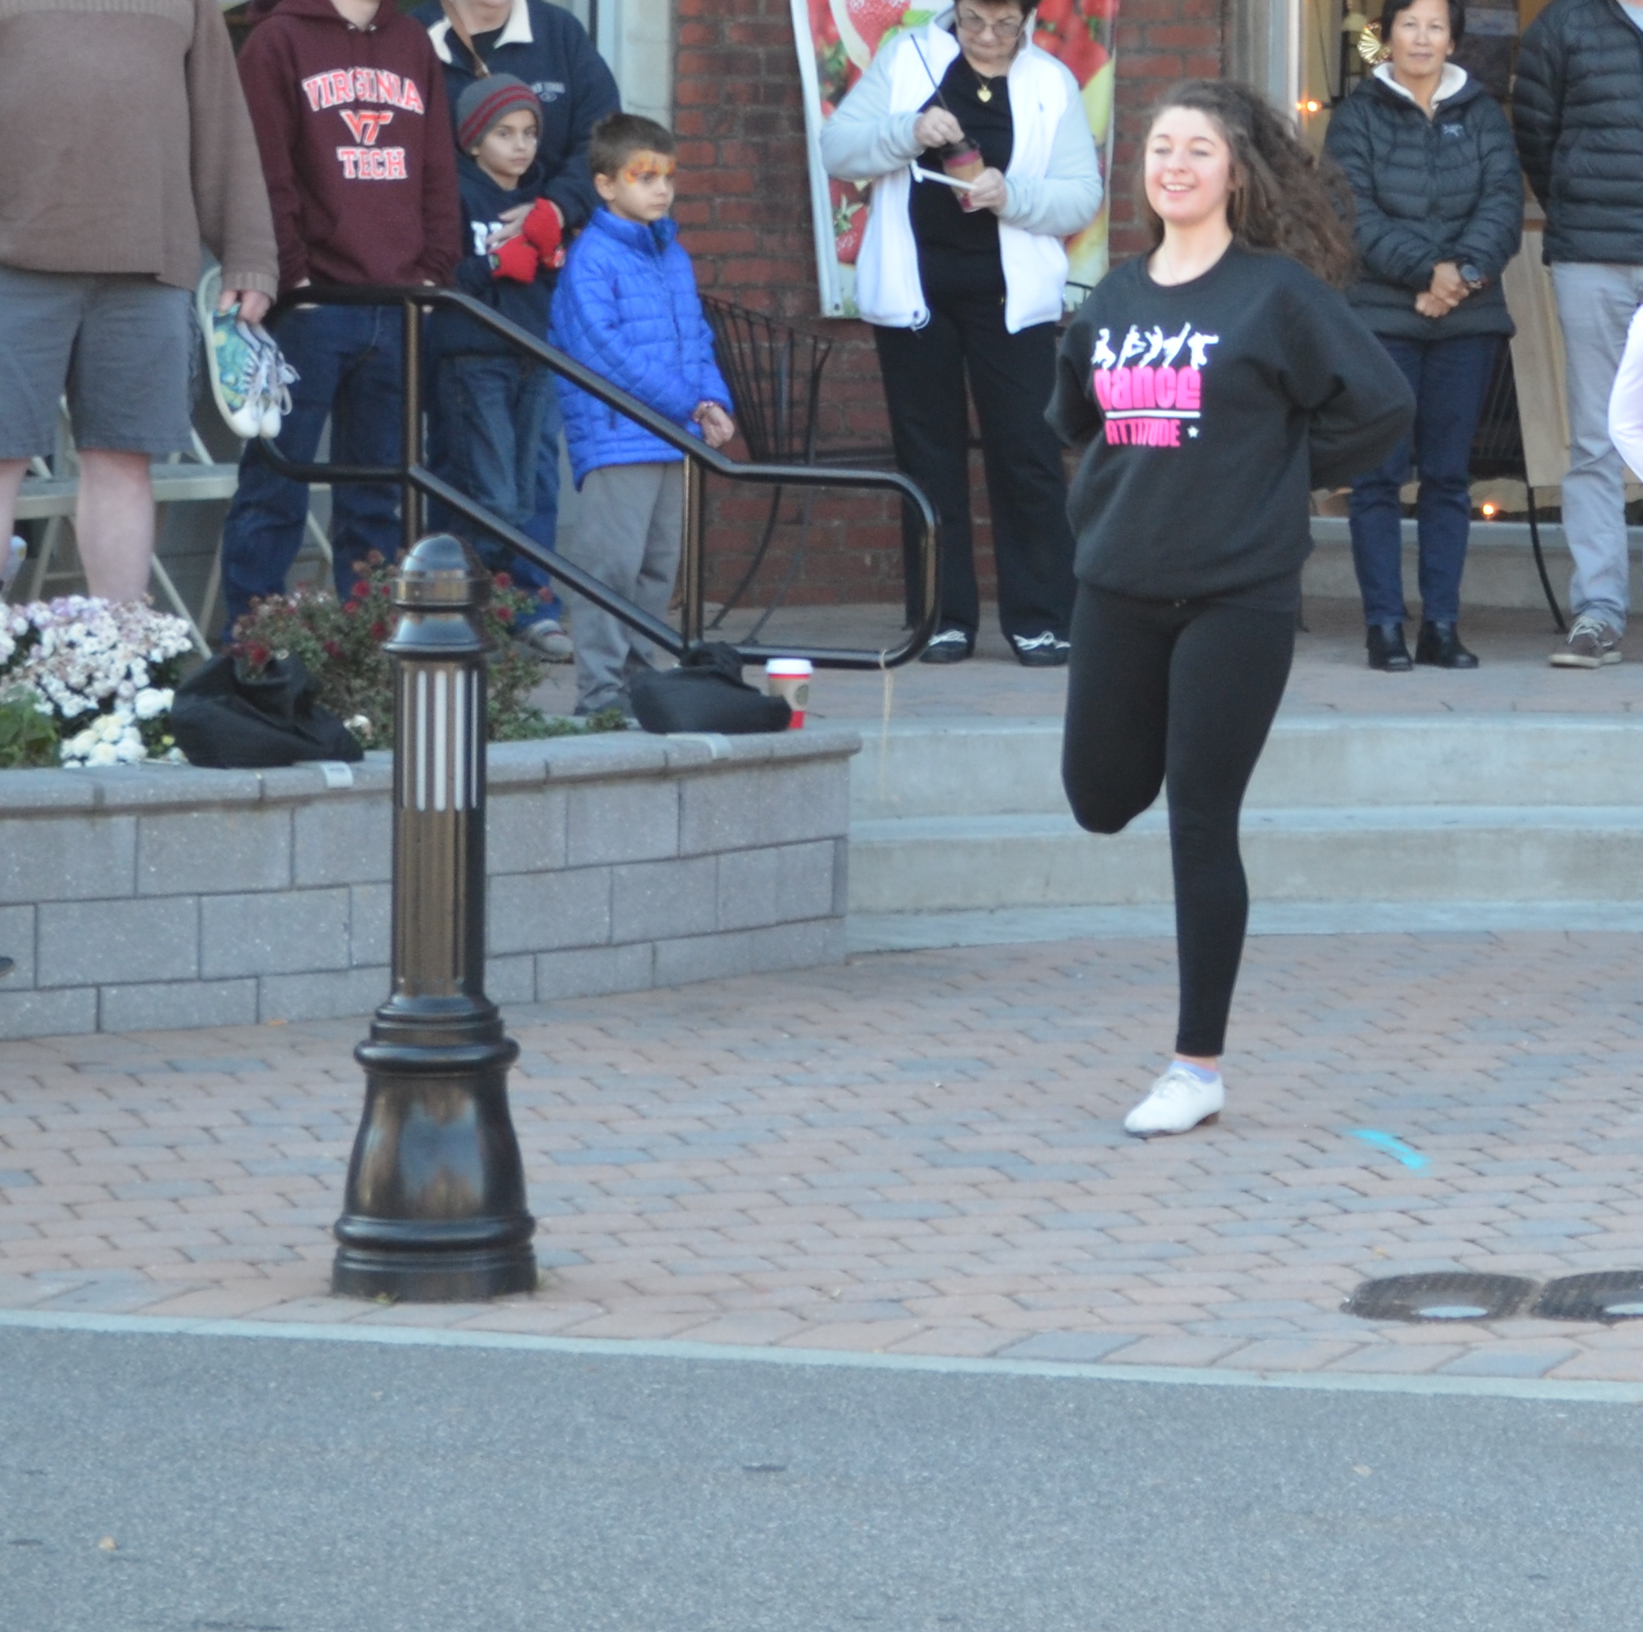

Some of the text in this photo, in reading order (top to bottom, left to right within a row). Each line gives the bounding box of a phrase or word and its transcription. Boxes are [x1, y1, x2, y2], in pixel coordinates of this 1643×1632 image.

[301, 66, 425, 116] VIRGINIA
[338, 109, 395, 146] VT
[336, 146, 408, 180] TECH
[1104, 417, 1182, 448] ATTITUDE
